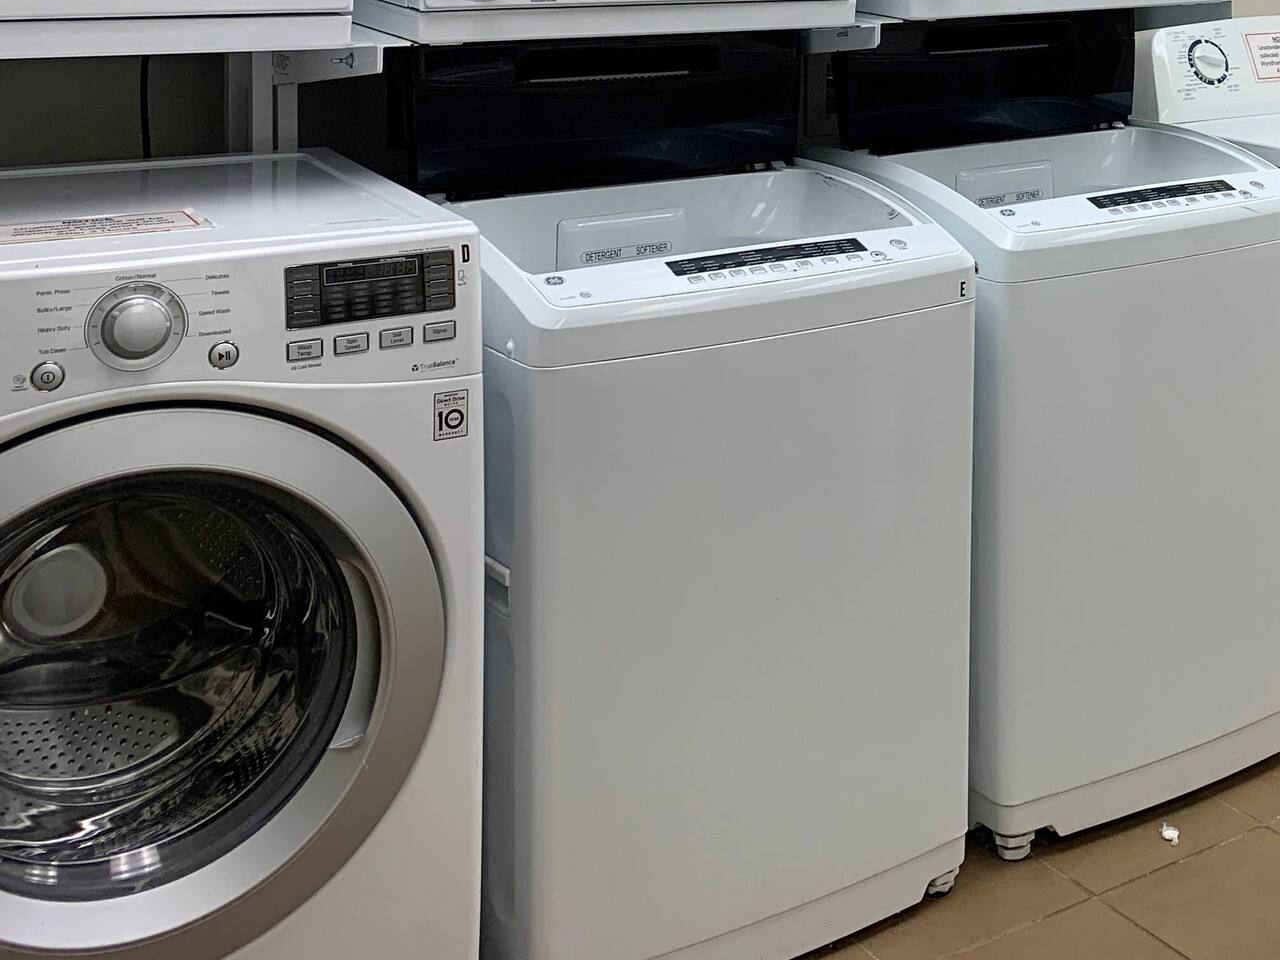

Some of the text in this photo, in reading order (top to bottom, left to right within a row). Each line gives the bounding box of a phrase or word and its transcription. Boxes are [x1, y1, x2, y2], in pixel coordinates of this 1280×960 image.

[461, 244, 470, 263] D
[585, 242, 668, 262] DETERGENT SOFTENER
[960, 281, 966, 297] E
[437, 409, 464, 431] 10
